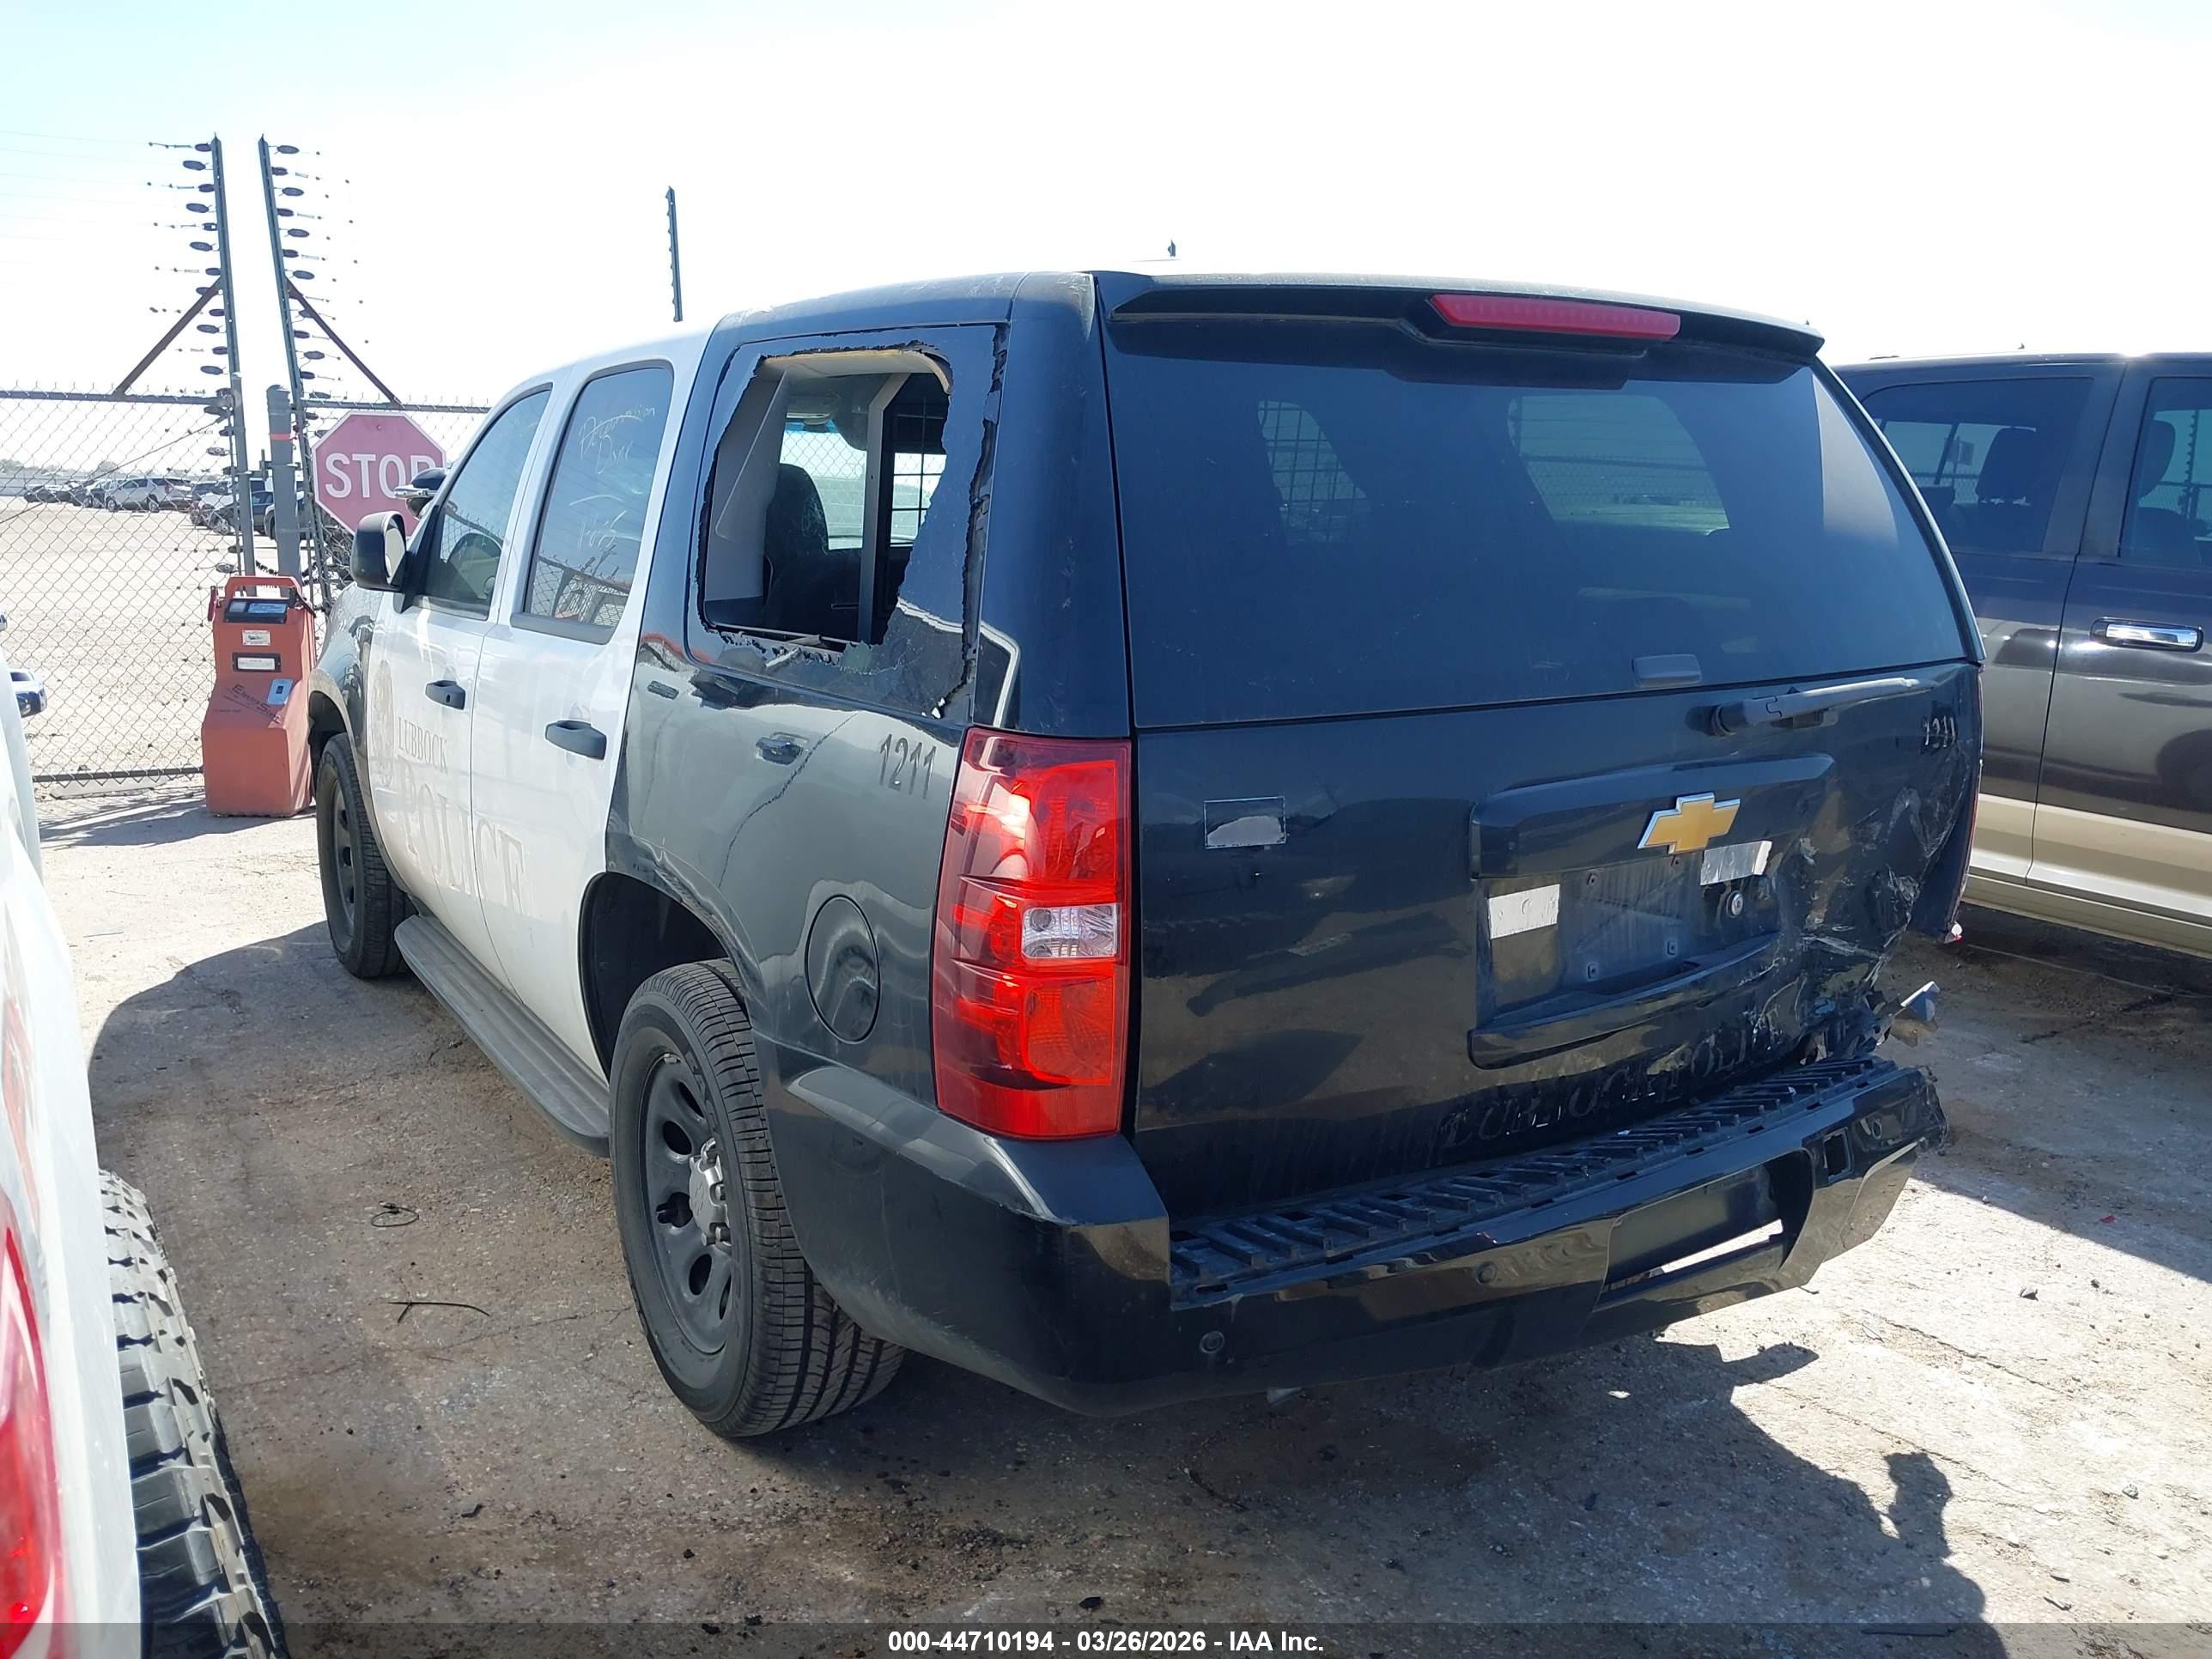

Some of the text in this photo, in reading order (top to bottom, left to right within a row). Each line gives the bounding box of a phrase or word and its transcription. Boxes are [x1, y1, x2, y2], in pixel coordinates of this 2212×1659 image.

[398, 717, 448, 773] LUBBOCK
[879, 733, 937, 799] 1211
[398, 754, 526, 915] POLICE
